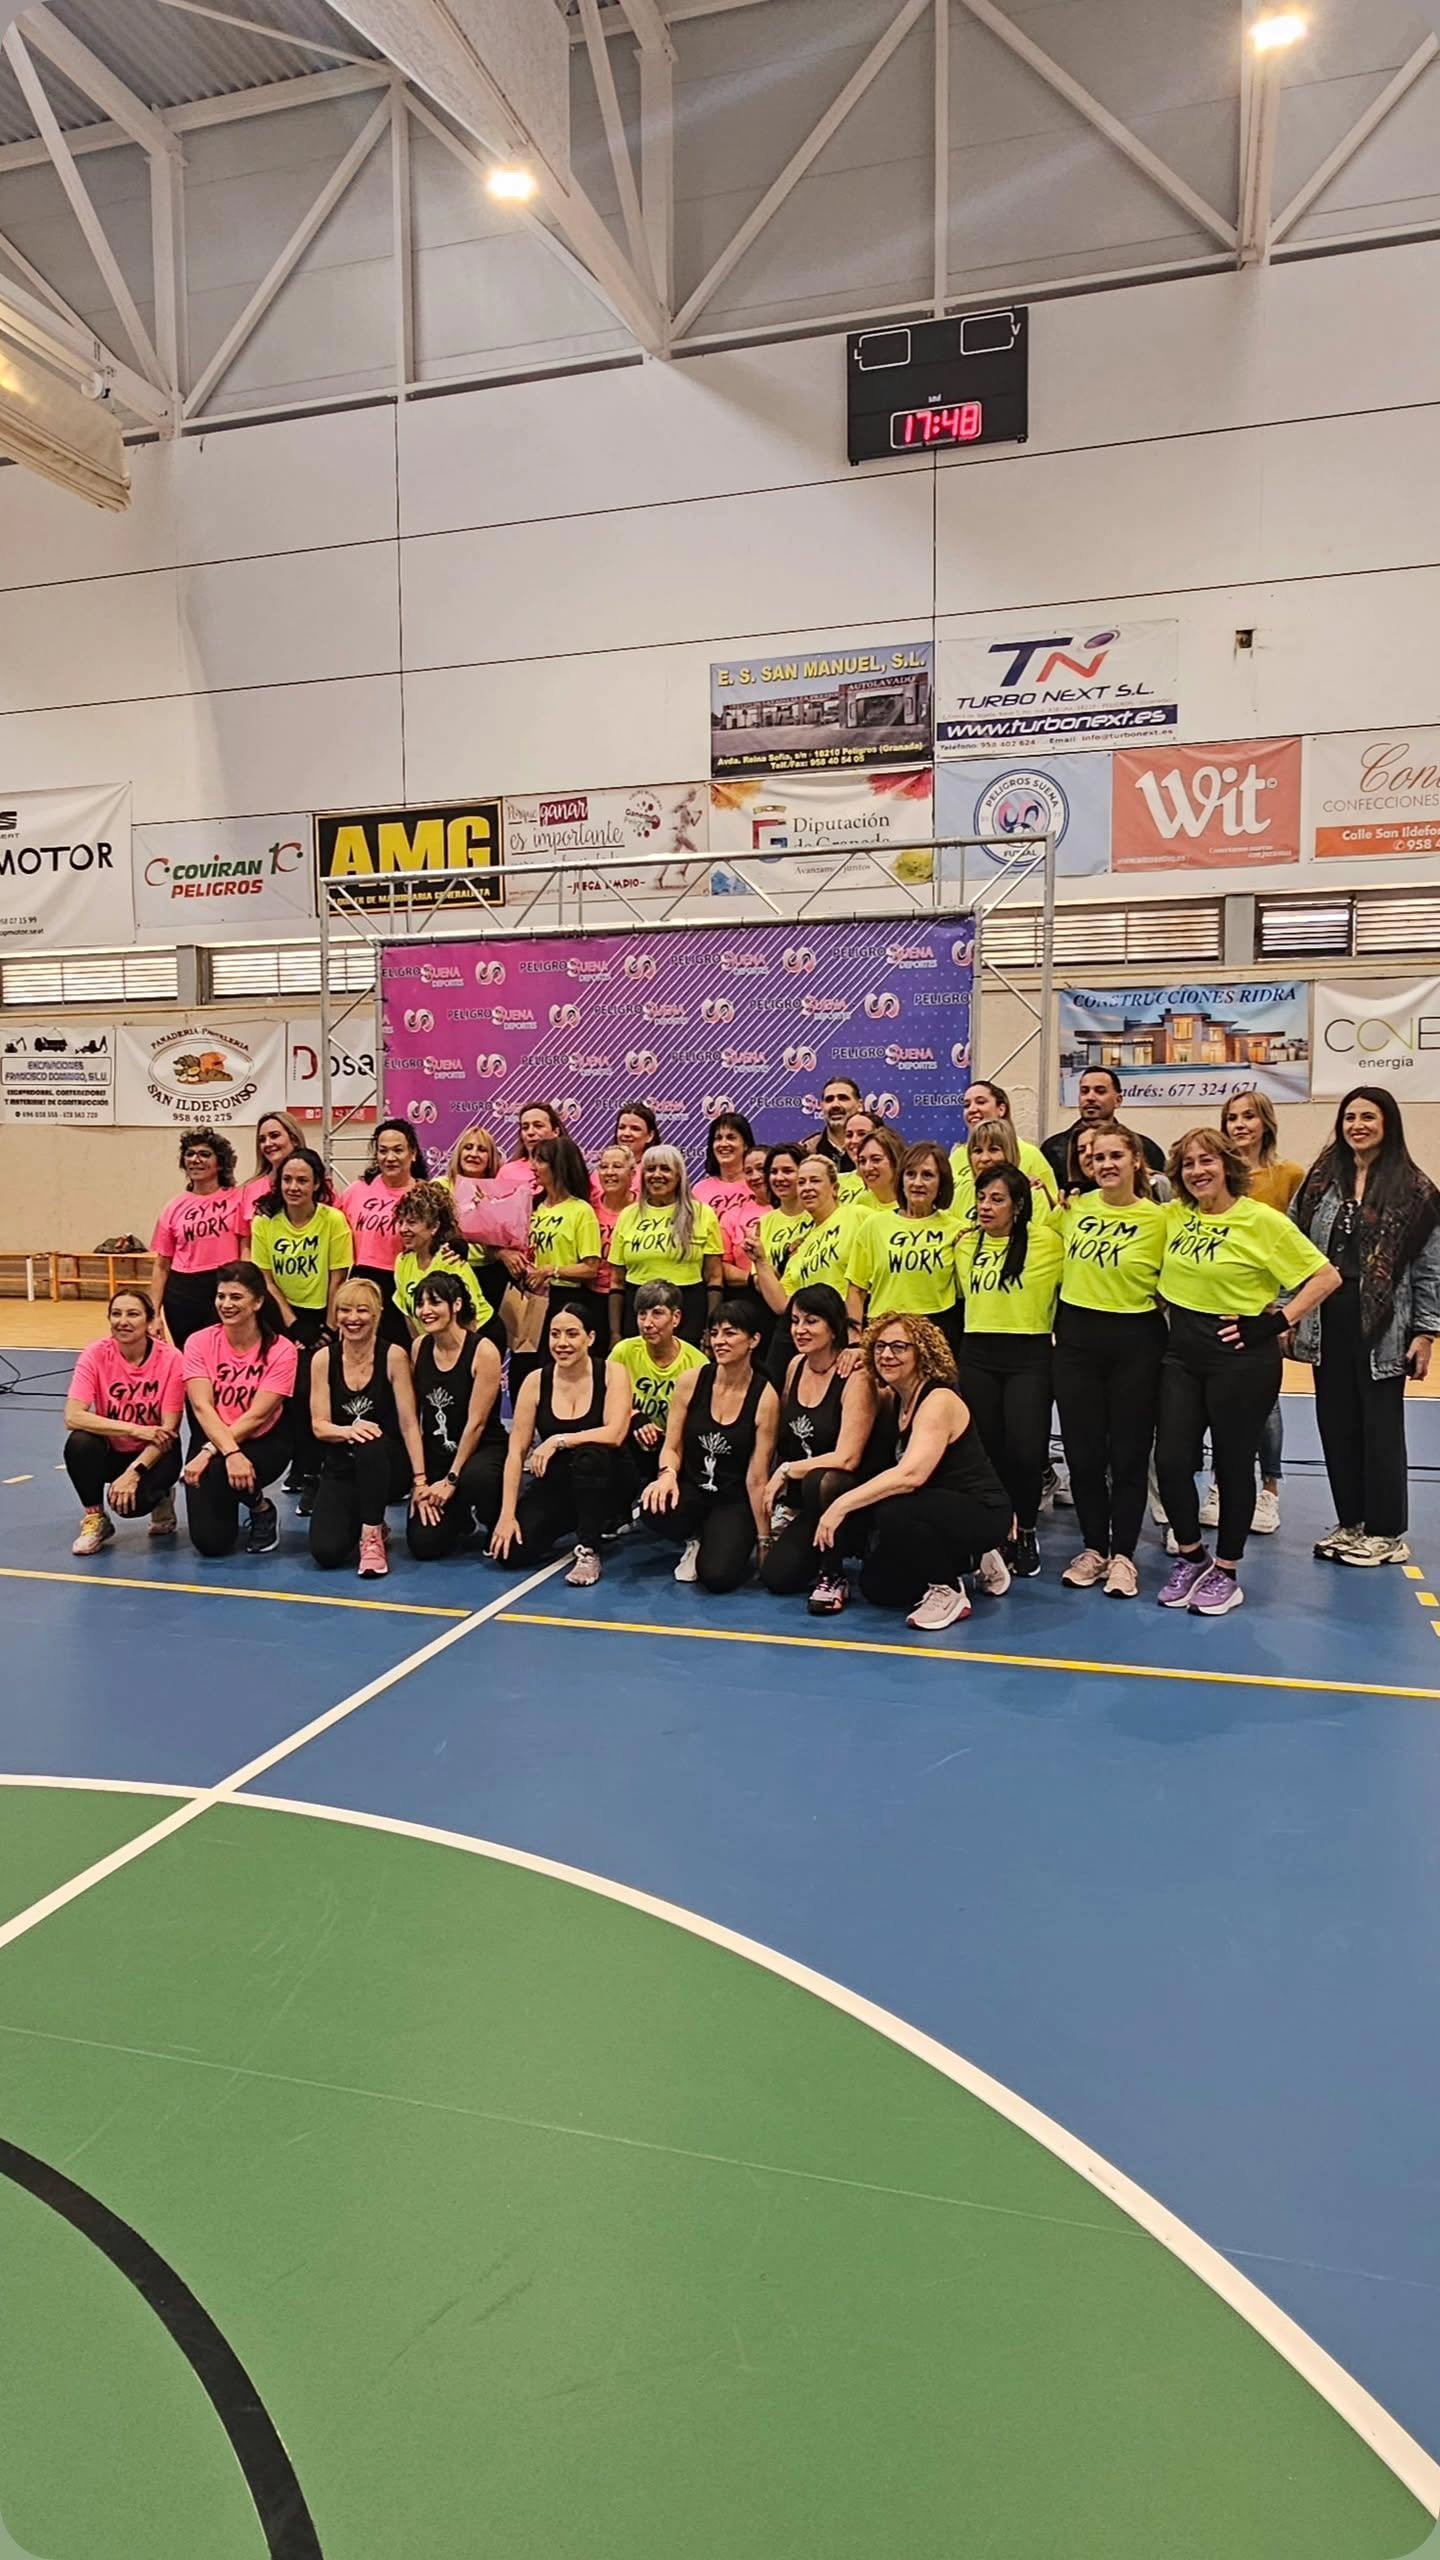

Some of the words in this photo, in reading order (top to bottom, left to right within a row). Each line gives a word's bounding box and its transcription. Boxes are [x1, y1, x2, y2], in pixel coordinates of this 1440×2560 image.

[904, 403, 979, 443] 17:48
[718, 670, 734, 687] E.
[739, 668, 756, 684] S.
[761, 665, 798, 683] SAN
[803, 654, 887, 679] MANUEL,
[891, 651, 926, 669] S.L.
[848, 675, 916, 692] AUTOLAVADO
[956, 692, 1036, 710] TURBO
[1041, 685, 1111, 702] NEXT
[1115, 682, 1155, 697] S.L.
[946, 708, 1167, 738] www.turbonext.es
[842, 746, 877, 758] Peligros
[879, 742, 923, 754] (Granada)
[985, 777, 1031, 808] PELIGROS
[1032, 779, 1060, 809] SUENA
[1135, 764, 1272, 839] Wit
[1322, 793, 1440, 812] CONFECCIONES
[540, 800, 588, 826] ganar
[793, 813, 890, 835] Diputación
[510, 834, 526, 850] es
[533, 821, 624, 854] importante
[1342, 828, 1373, 841] Calle
[1375, 827, 1399, 839] San
[1406, 839, 1431, 850] 958
[328, 815, 491, 889] AMG
[172, 855, 263, 881] COVIRAN
[795, 864, 837, 875] Avanzam
[170, 878, 264, 899] PELIGROS
[382, 967, 421, 978] ELIGRO
[1239, 986, 1297, 1003] RIDRA
[384, 1058, 425, 1069] ELIGRO
[147, 1084, 174, 1107] SAN
[175, 1083, 258, 1112] ILDEFONSO
[1121, 1085, 1164, 1098] drés:
[1168, 1083, 1195, 1097] 677
[1200, 1082, 1227, 1096] 324
[173, 1113, 191, 1121] 958
[194, 1113, 212, 1122] 402
[215, 1112, 233, 1121] 275
[363, 1197, 395, 1212] GY
[839, 1187, 868, 1203] GY
[184, 1199, 228, 1221] GYM
[183, 1214, 231, 1242] WORK
[531, 1215, 564, 1229] YM
[772, 1220, 815, 1243] GYM
[1077, 1215, 1139, 1240] GYM
[273, 1235, 319, 1255] GYM
[529, 1231, 558, 1254] ORK
[889, 1230, 944, 1246] GYM
[1169, 1229, 1225, 1265] WORK
[800, 1241, 839, 1281] WORK
[888, 1248, 944, 1275] WORK
[973, 1250, 1006, 1269] GY
[1067, 1233, 1128, 1268] WORK
[272, 1253, 319, 1279] WORK
[216, 1362, 265, 1383] GYM
[109, 1380, 159, 1401] GYM
[107, 1400, 162, 1426] WORK
[632, 1393, 669, 1424] WOR
